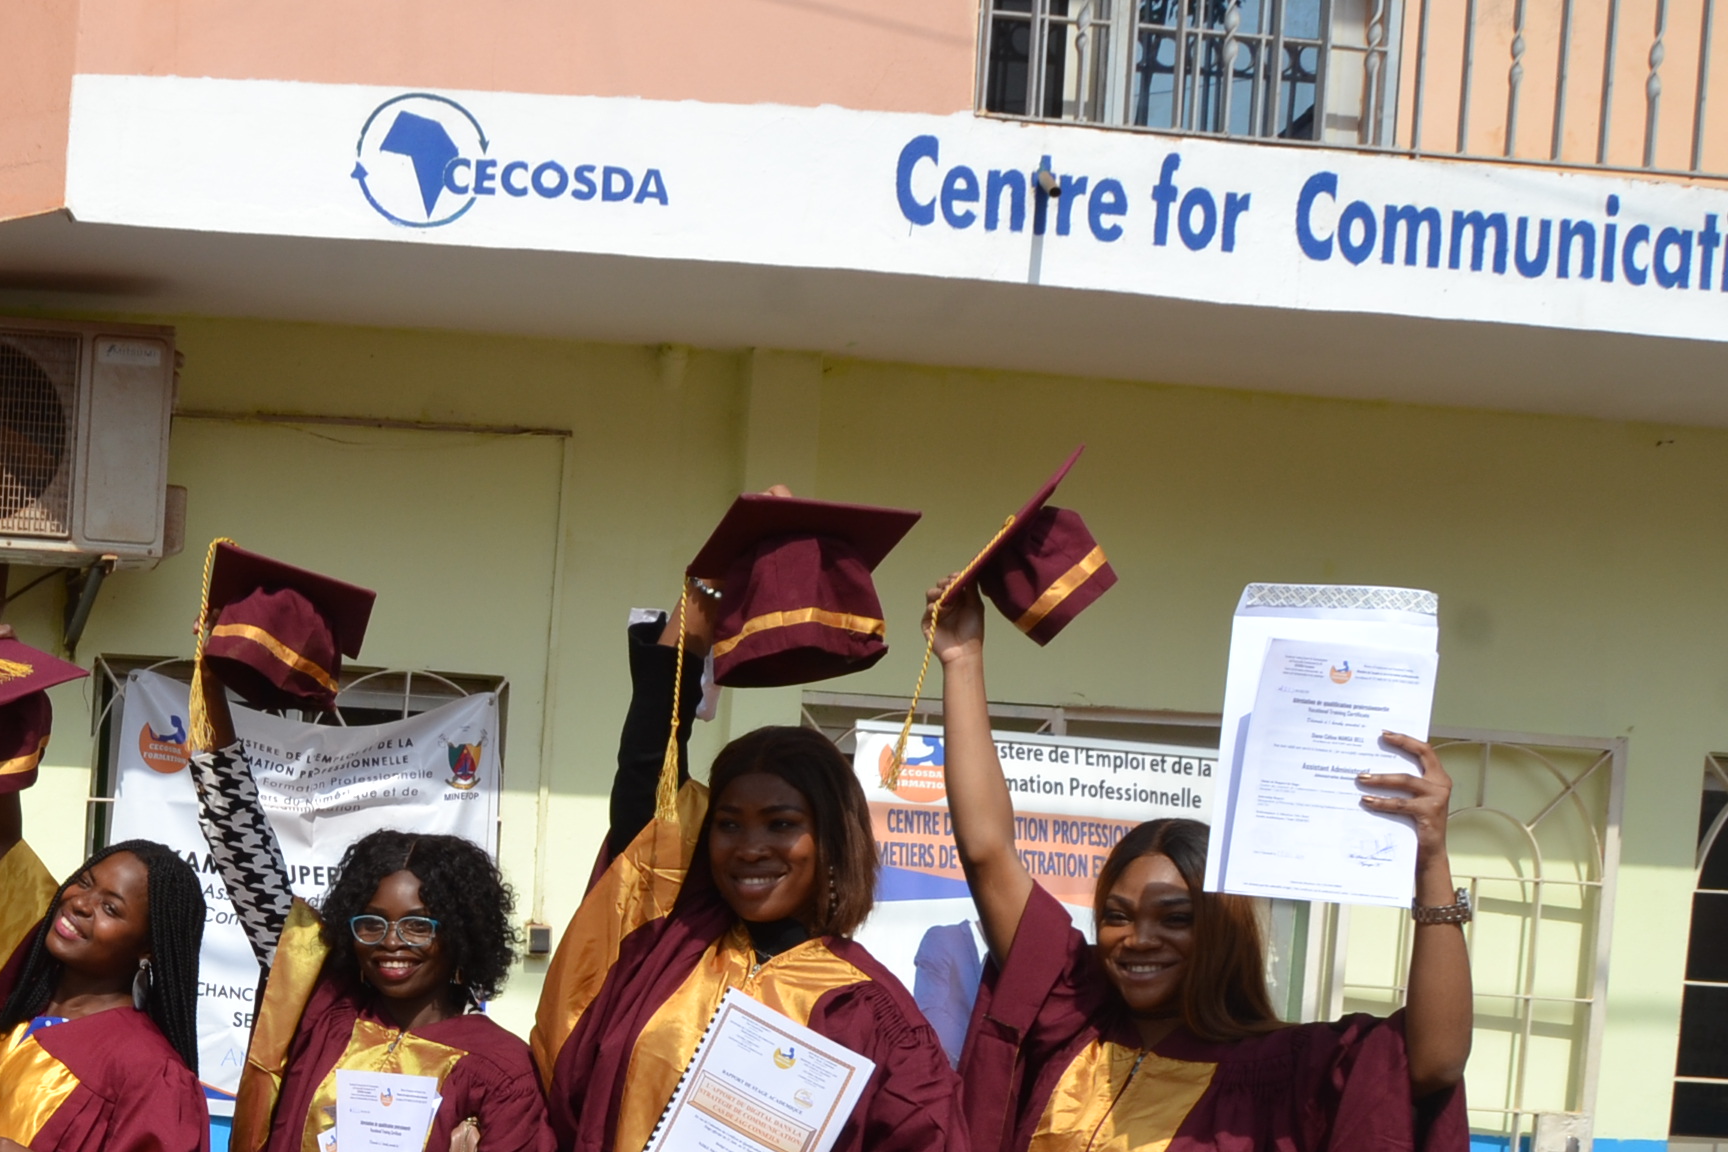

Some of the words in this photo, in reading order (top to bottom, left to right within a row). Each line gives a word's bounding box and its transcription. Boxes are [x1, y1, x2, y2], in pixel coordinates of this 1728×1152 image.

[443, 157, 669, 206] CECOSDA
[896, 135, 1128, 244] Centre
[1151, 152, 1251, 253] for
[243, 738, 280, 756] STERE
[286, 752, 302, 761] DE
[377, 740, 393, 750] DE
[399, 738, 414, 748] LA
[1048, 746, 1070, 764] de
[1074, 747, 1146, 774] l'Emploi
[1150, 754, 1167, 773] et
[1171, 756, 1193, 775] de
[1197, 758, 1212, 777] la
[402, 787, 419, 797] de
[1069, 777, 1203, 809] Professionnelle
[887, 808, 940, 836] CENTRE
